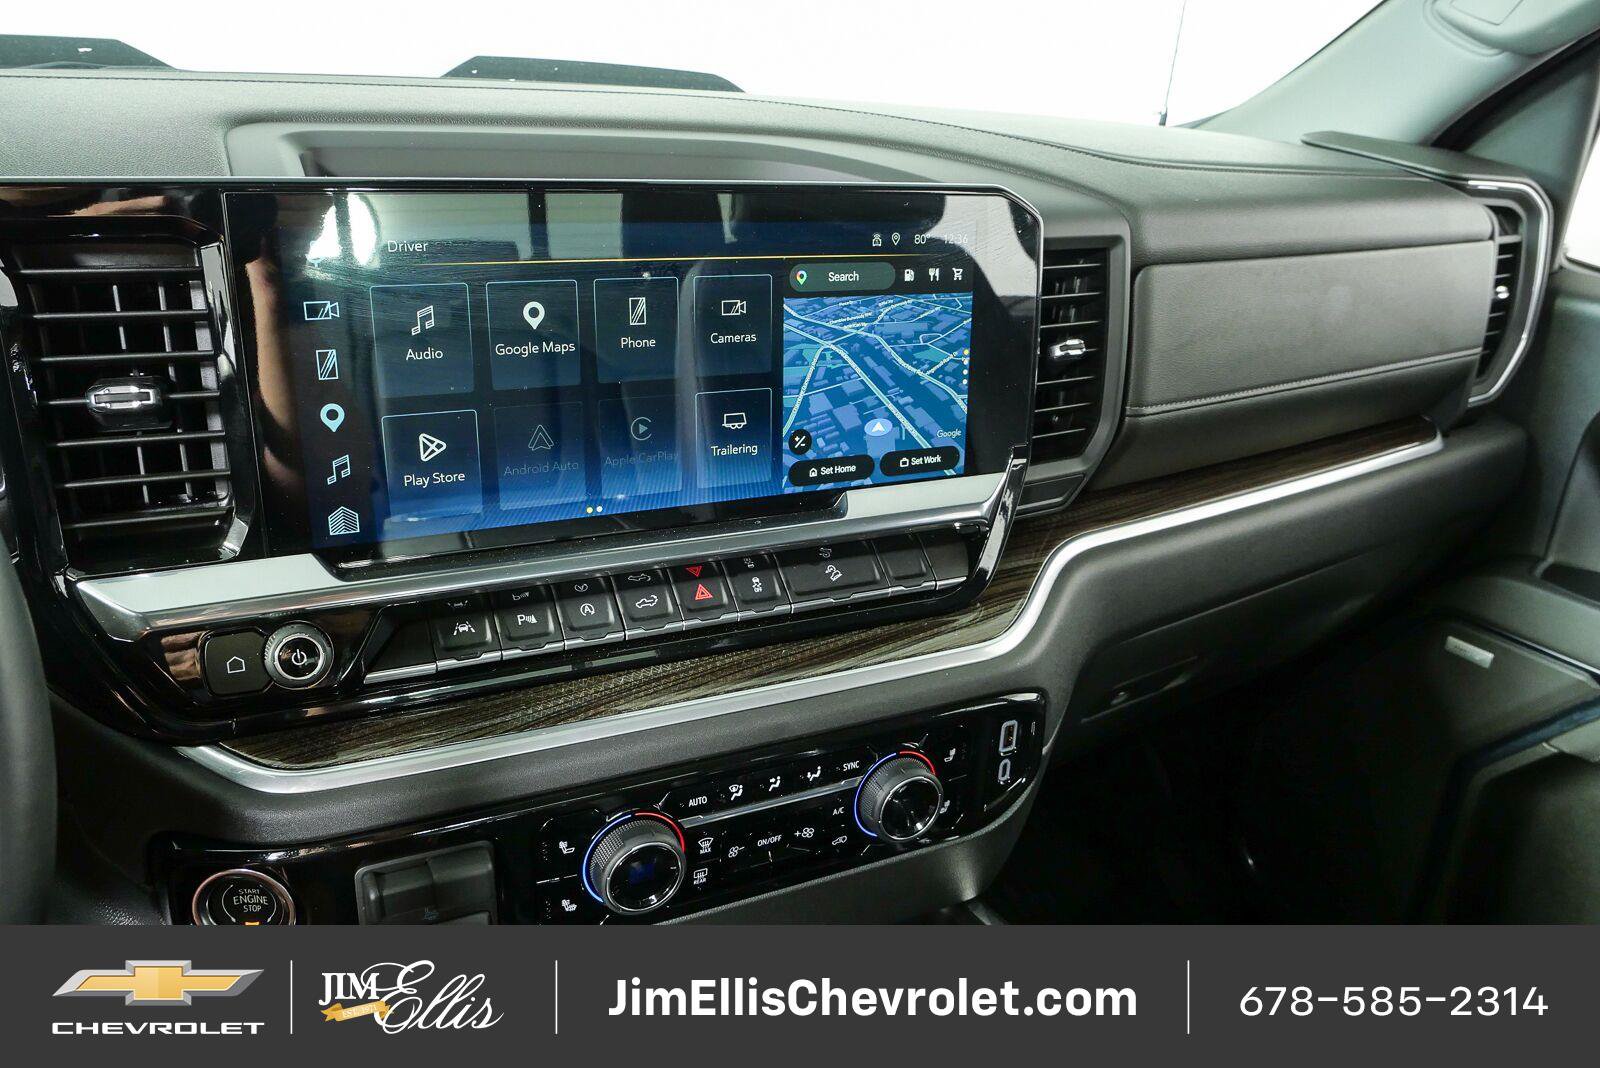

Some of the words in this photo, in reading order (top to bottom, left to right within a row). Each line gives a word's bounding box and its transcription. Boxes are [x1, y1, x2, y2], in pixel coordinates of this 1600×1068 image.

[387, 240, 429, 253] Driver
[827, 270, 860, 283] Search
[620, 337, 656, 349] Phone
[711, 332, 757, 344] Cameras
[405, 347, 444, 361] Audio
[495, 342, 539, 358] Google
[542, 341, 576, 357] Maps
[936, 429, 962, 439] Google
[711, 442, 759, 458] Trailering
[605, 455, 636, 468] Apple
[638, 450, 680, 465] CarPlay
[910, 457, 922, 467] Set
[923, 455, 942, 465] Work
[503, 460, 550, 477] Android
[553, 460, 580, 473] Auto
[820, 465, 833, 476] Set
[834, 464, 857, 474] Home
[403, 473, 430, 489] Play
[432, 470, 466, 485] Store
[842, 760, 859, 771] SYNC
[688, 795, 707, 807] AUTO
[832, 806, 845, 817] A/C
[757, 835, 781, 847] ON/OFF
[233, 894, 268, 905] ENGINE
